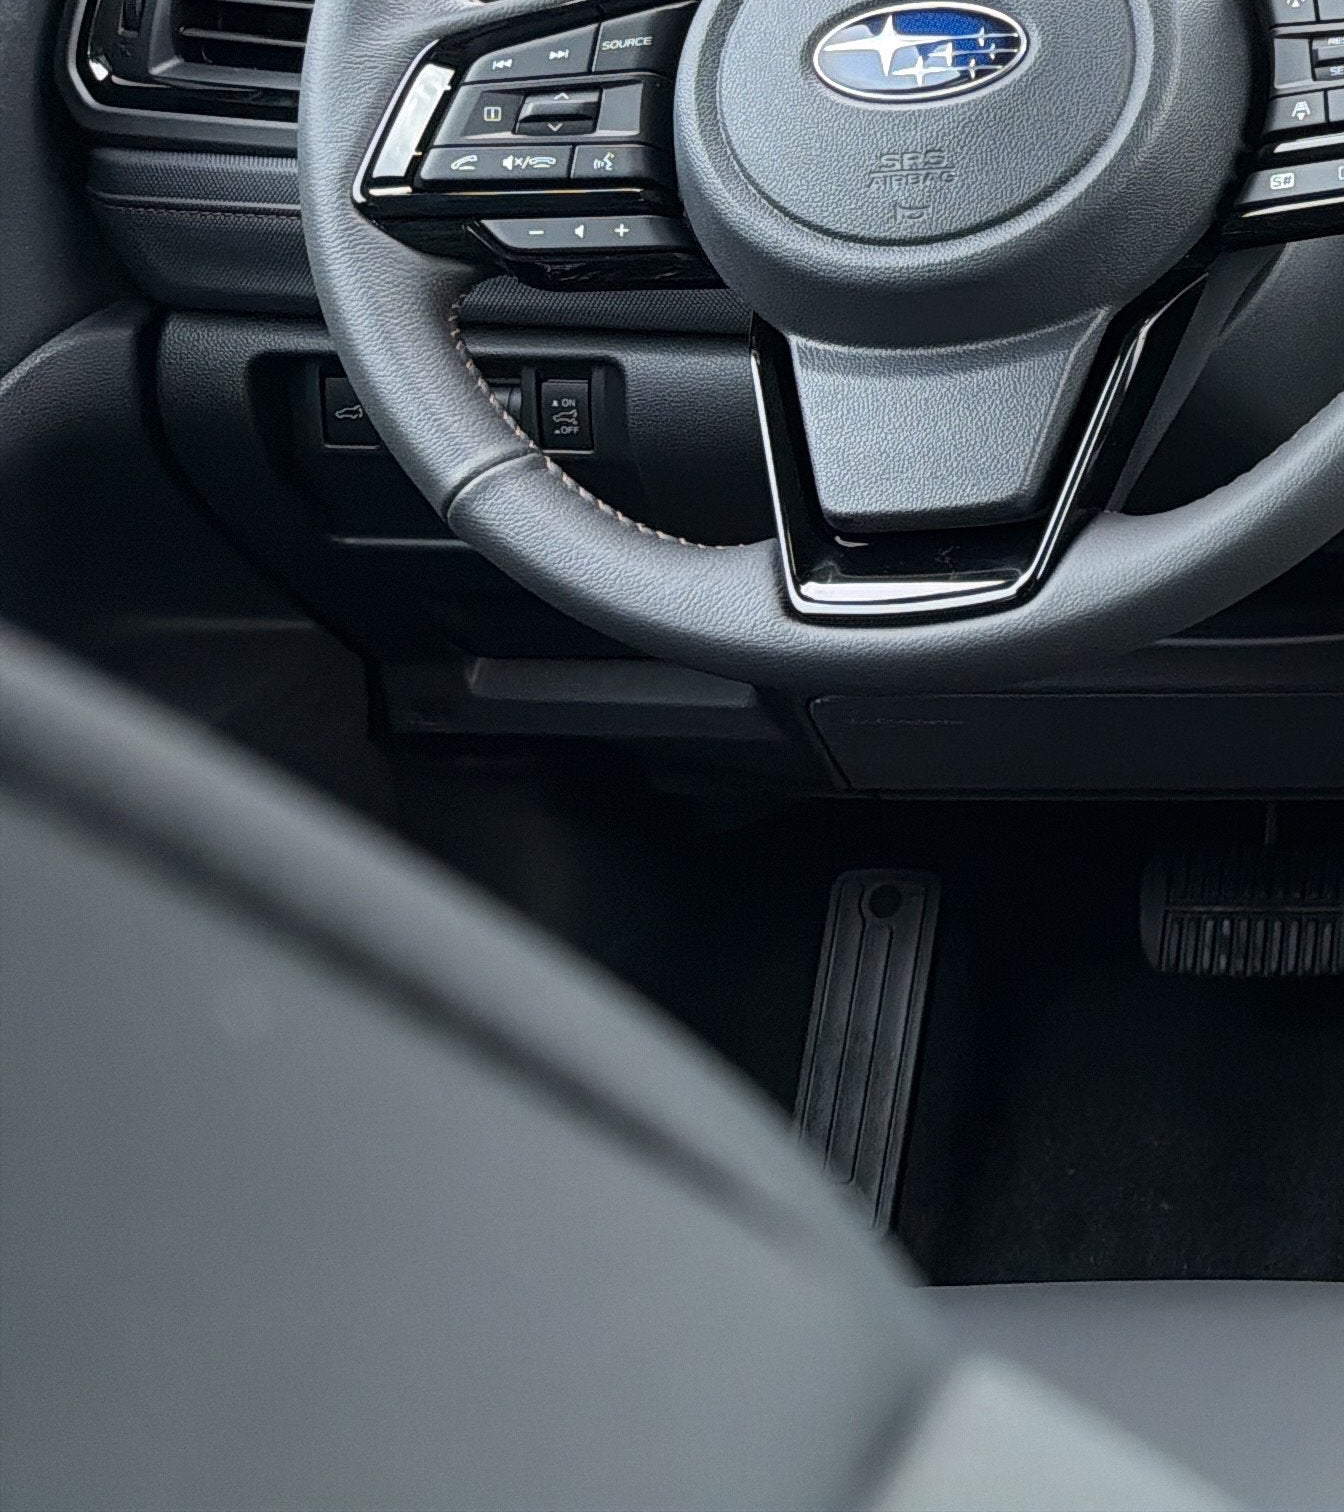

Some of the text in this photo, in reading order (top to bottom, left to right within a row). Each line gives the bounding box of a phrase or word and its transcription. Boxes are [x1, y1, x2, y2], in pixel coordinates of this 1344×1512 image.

[602, 35, 653, 51] SOURCE
[561, 397, 576, 408] ON
[560, 425, 580, 435] OFF
